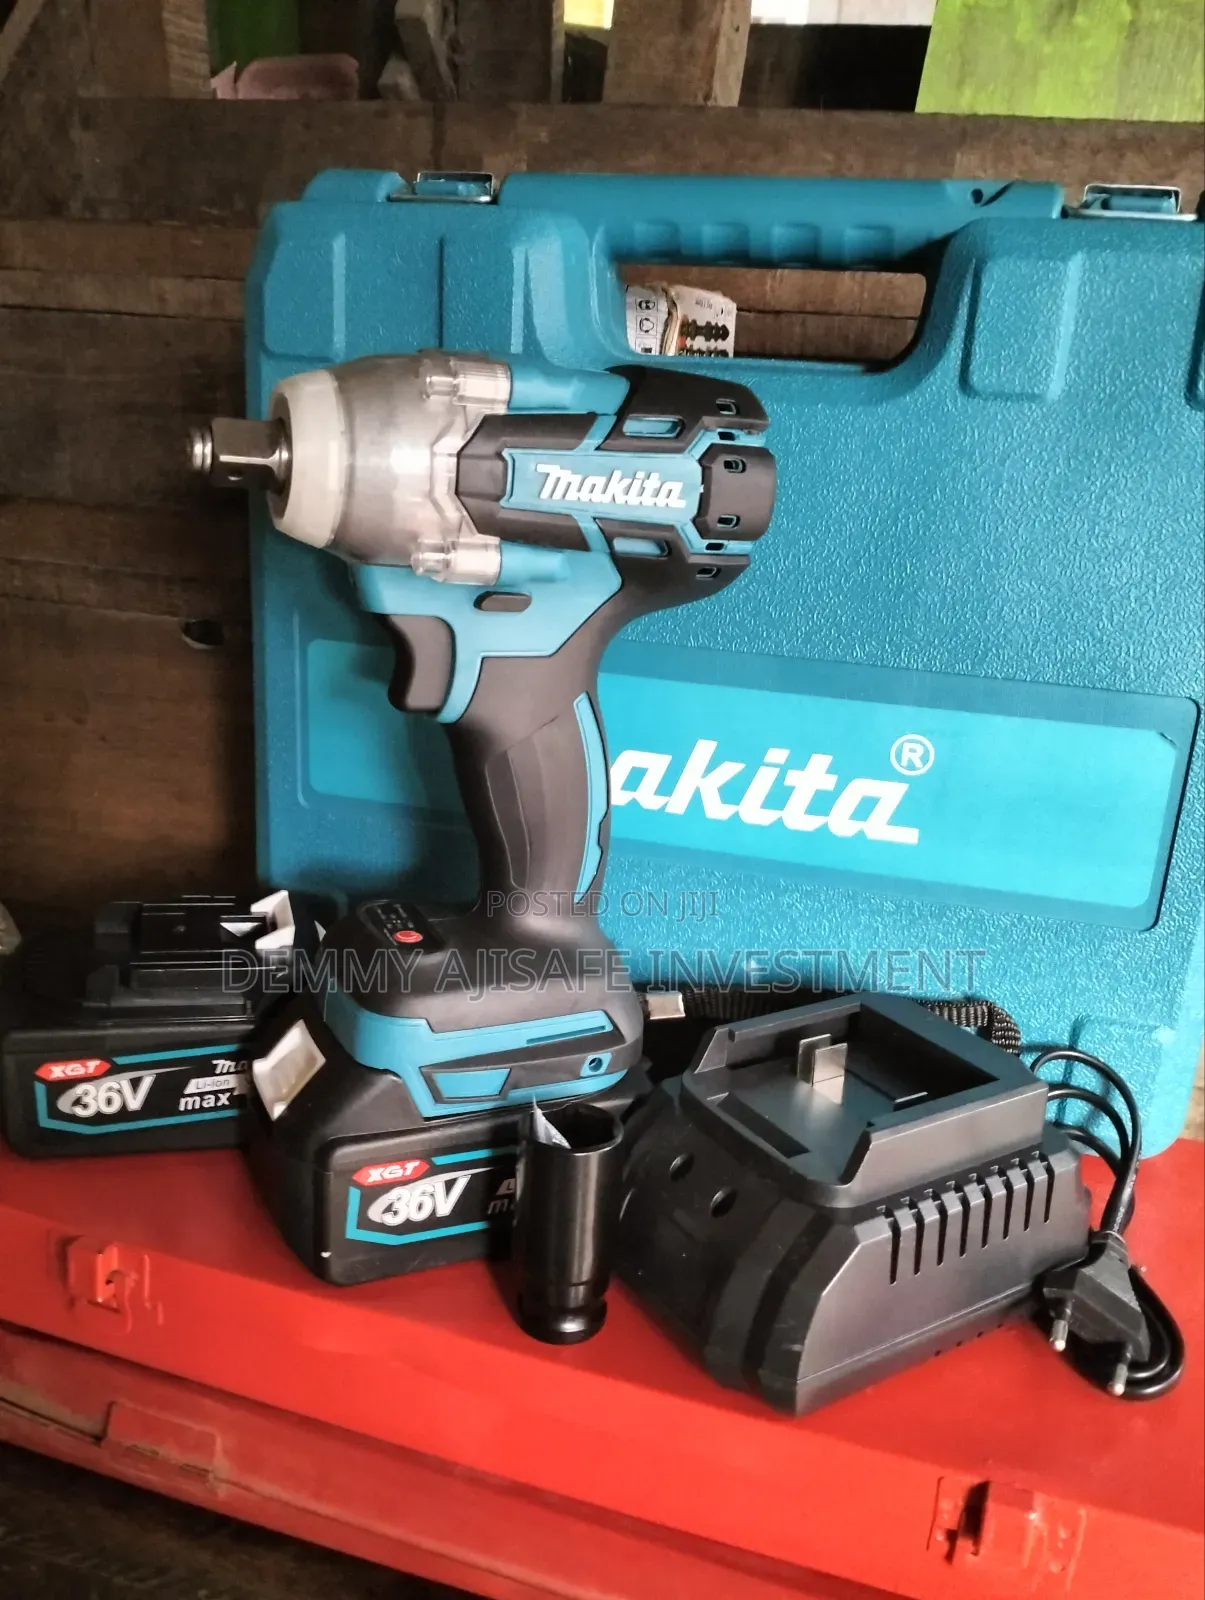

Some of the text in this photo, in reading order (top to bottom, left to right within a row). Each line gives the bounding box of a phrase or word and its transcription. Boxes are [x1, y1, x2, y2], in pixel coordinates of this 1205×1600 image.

[49, 1060, 102, 1079] XGT
[72, 1073, 157, 1118] 36V
[178, 1092, 232, 1112] max
[366, 1160, 421, 1183] XGT
[380, 1174, 472, 1226] 36V
